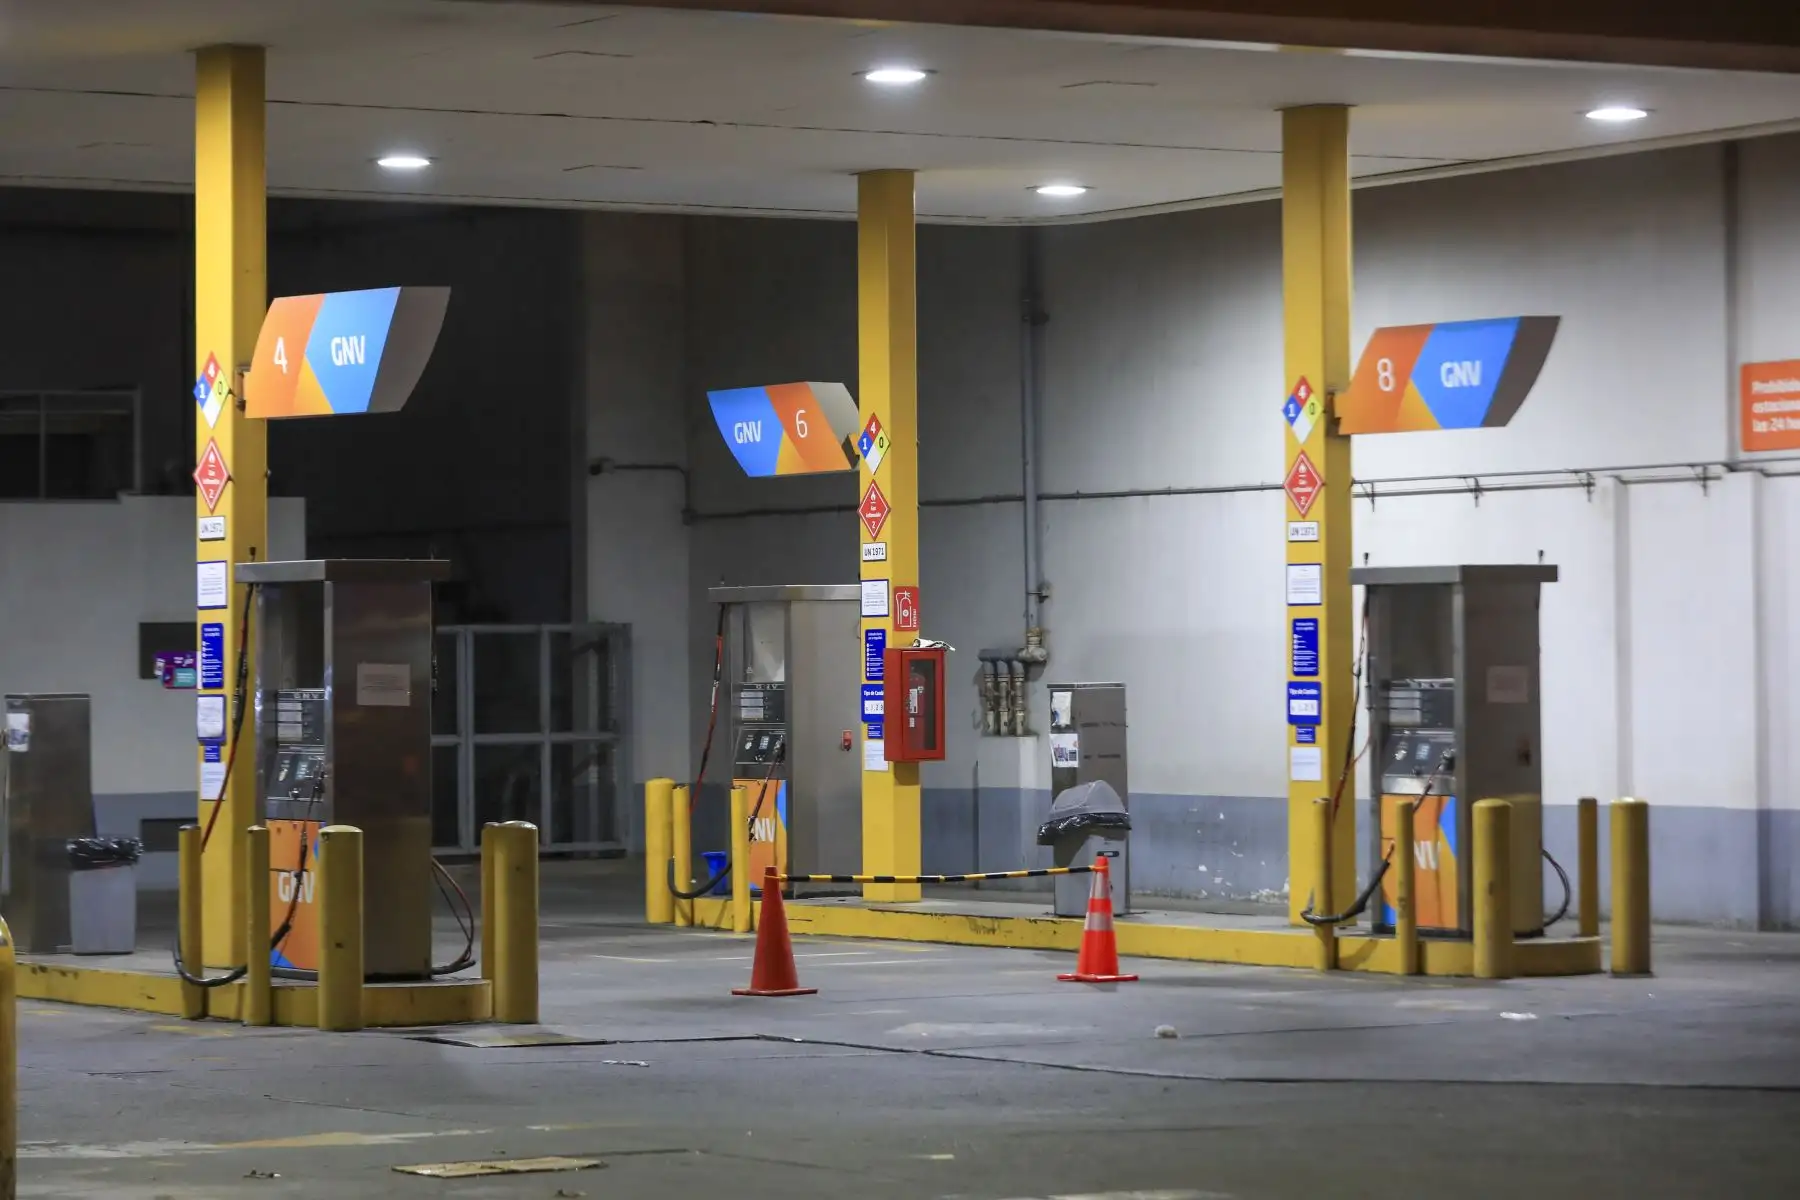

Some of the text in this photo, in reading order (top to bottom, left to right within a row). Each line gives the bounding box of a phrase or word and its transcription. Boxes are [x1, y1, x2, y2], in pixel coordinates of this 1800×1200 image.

[273, 336, 288, 374] 4
[330, 335, 366, 366] GNV
[207, 361, 216, 379] 4
[1377, 358, 1395, 392] 8
[1440, 360, 1482, 388] GNV
[199, 383, 206, 399] 1
[1288, 403, 1296, 418] 1
[734, 420, 761, 444] GNV
[795, 409, 808, 438] 6
[870, 421, 876, 434] 4
[862, 437, 867, 450] 1
[879, 436, 884, 449] 0
[871, 520, 876, 529] 2
[864, 547, 884, 557] UN 1971
